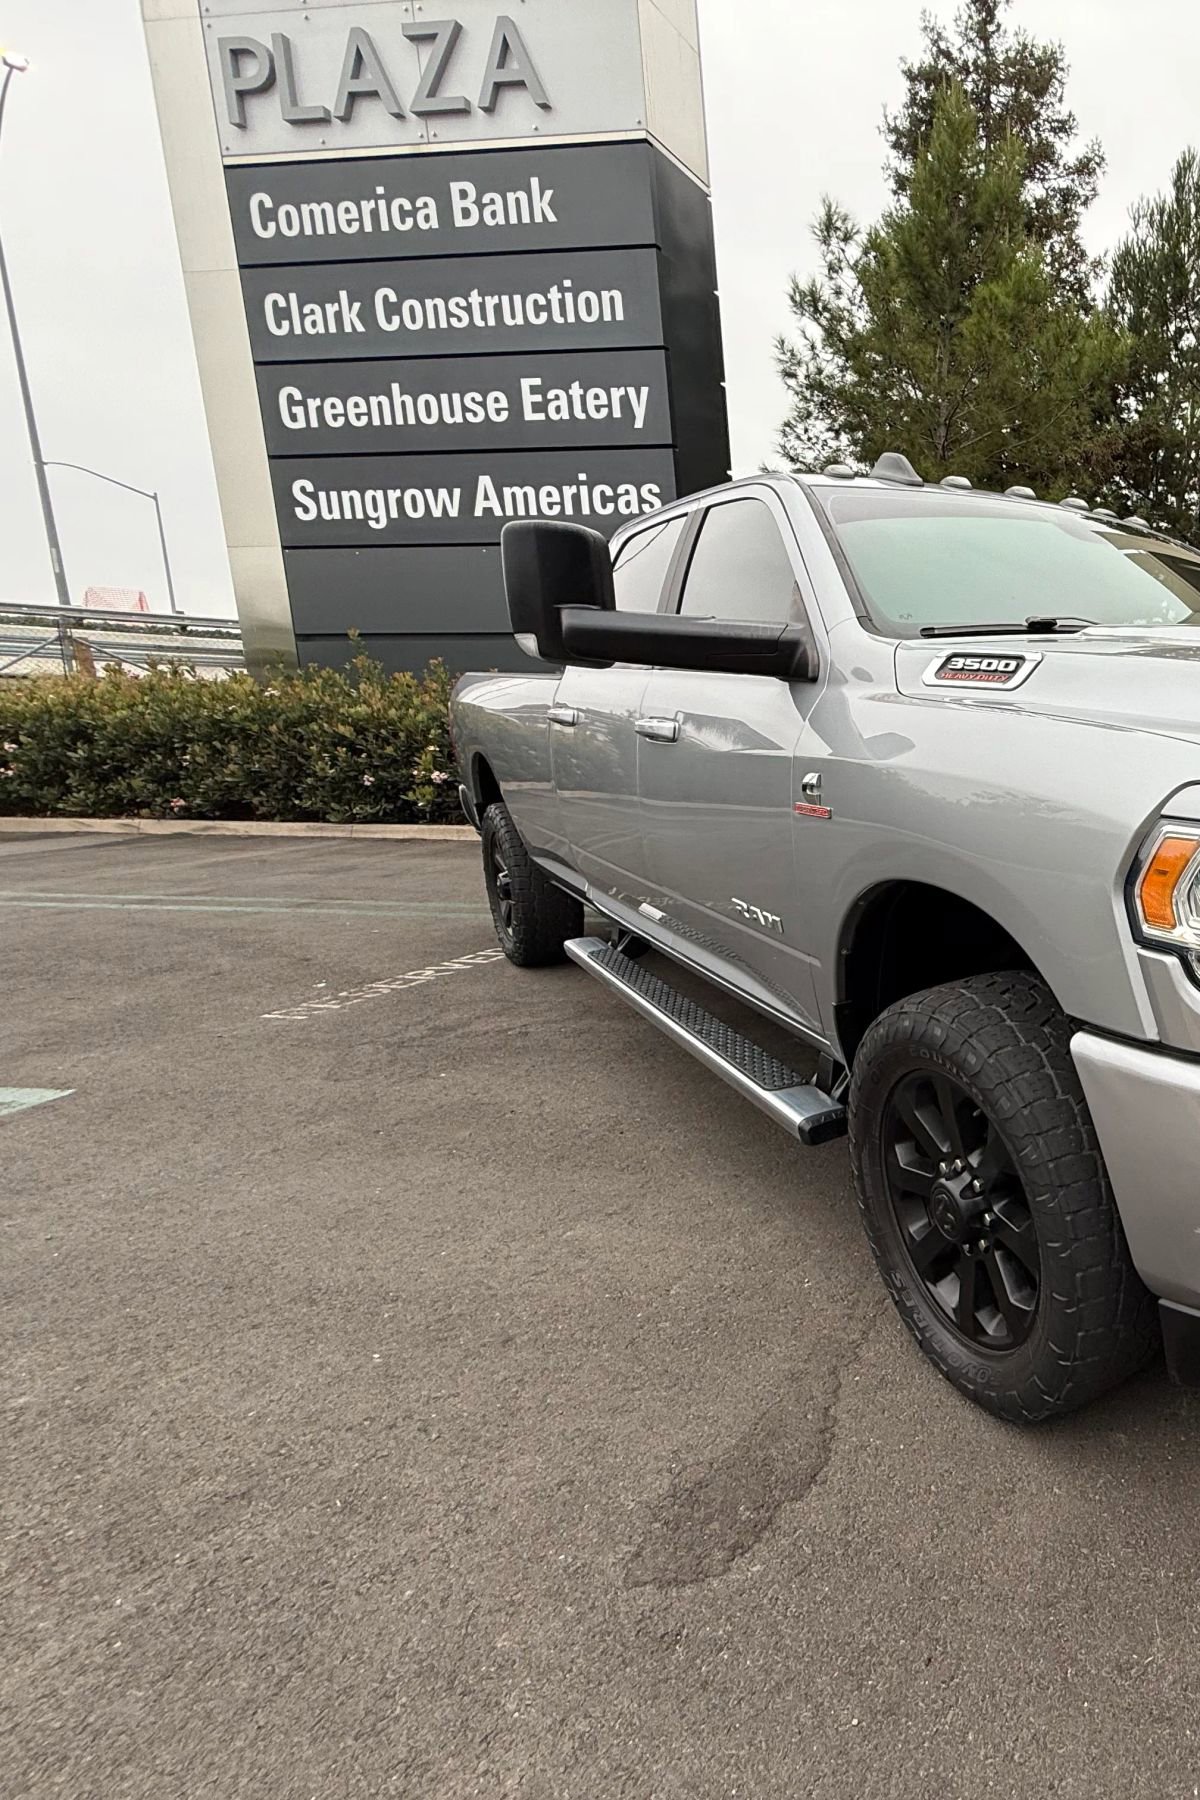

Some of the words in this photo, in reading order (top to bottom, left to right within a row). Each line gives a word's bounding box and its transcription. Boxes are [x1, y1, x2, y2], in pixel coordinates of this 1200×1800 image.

[217, 14, 552, 128] PLAZA
[249, 185, 440, 239] Comerica
[449, 176, 558, 228] Bank
[264, 289, 366, 336] Clark
[374, 279, 625, 332] Construction
[278, 382, 509, 430] Greenhouse
[519, 377, 649, 429] Eatery
[291, 478, 461, 530] Sungrow
[473, 472, 663, 519] Americas
[947, 656, 1018, 673] 3500
[731, 897, 785, 934] RAM
